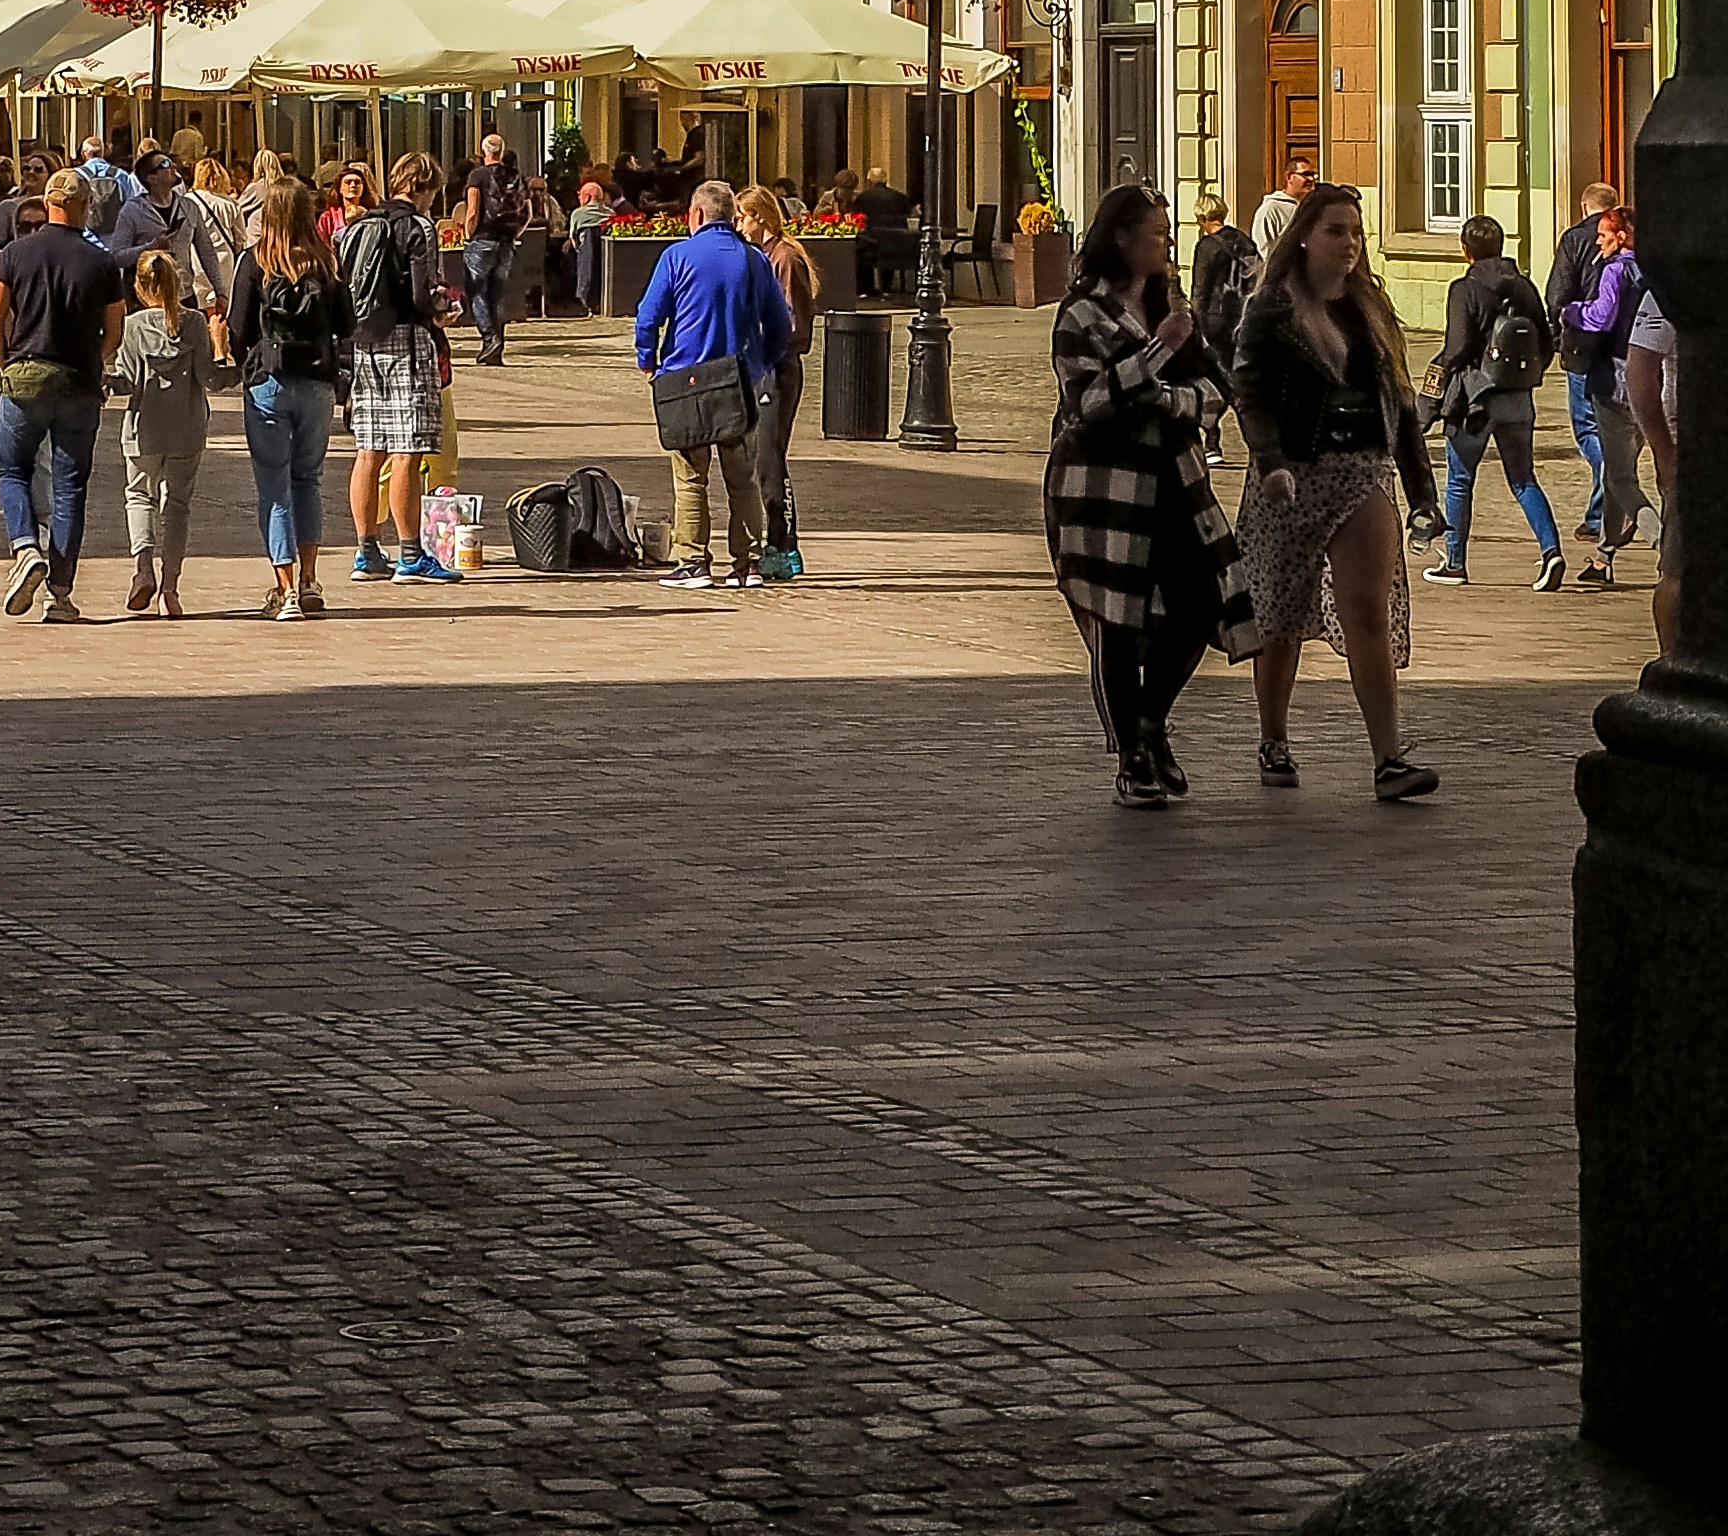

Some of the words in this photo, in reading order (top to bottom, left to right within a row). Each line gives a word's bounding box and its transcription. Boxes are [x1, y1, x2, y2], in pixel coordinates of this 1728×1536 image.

[306, 64, 379, 81] TYSKIE
[511, 54, 582, 75] TYSKIE
[695, 61, 768, 82] TYSKIE
